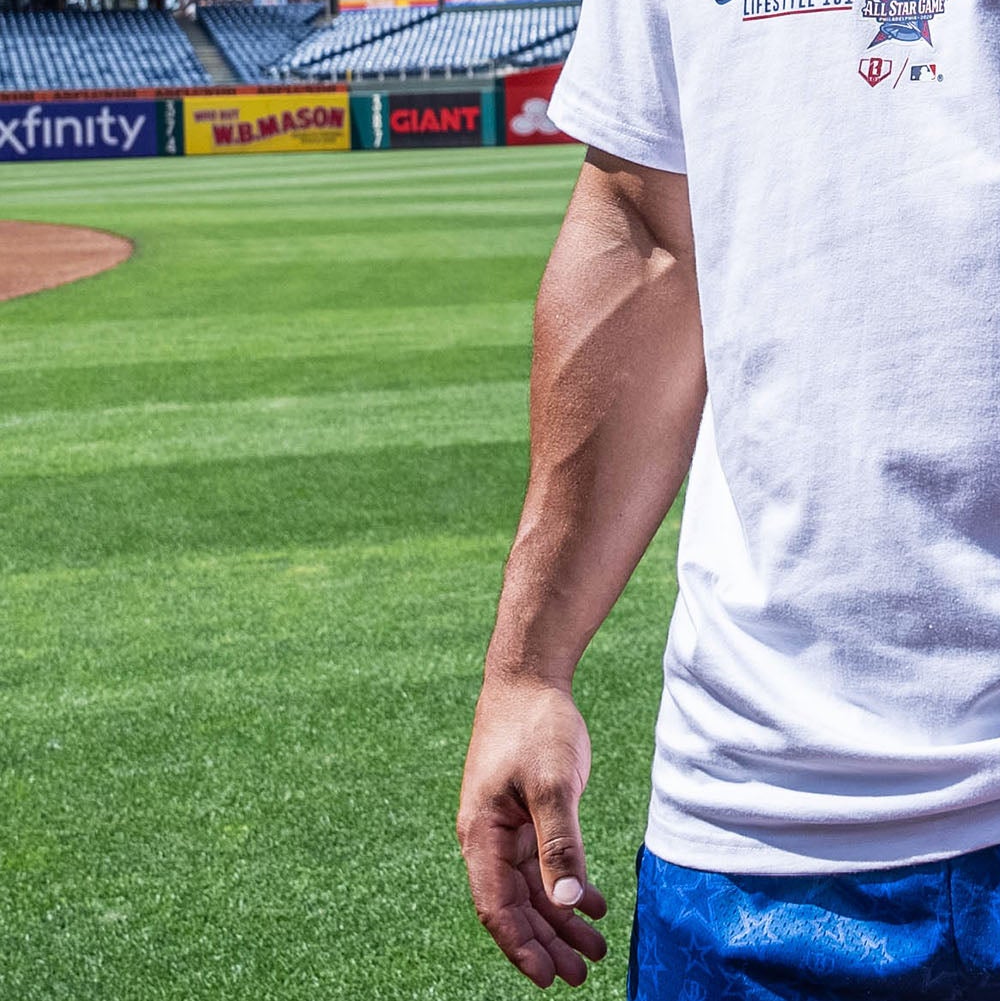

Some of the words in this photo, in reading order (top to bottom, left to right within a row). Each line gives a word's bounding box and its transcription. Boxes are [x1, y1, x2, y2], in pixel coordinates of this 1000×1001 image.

[863, 0, 887, 17] ALL
[889, 0, 917, 17] STAR
[0, 105, 146, 154] xfinity
[390, 106, 481, 134] GIANT
